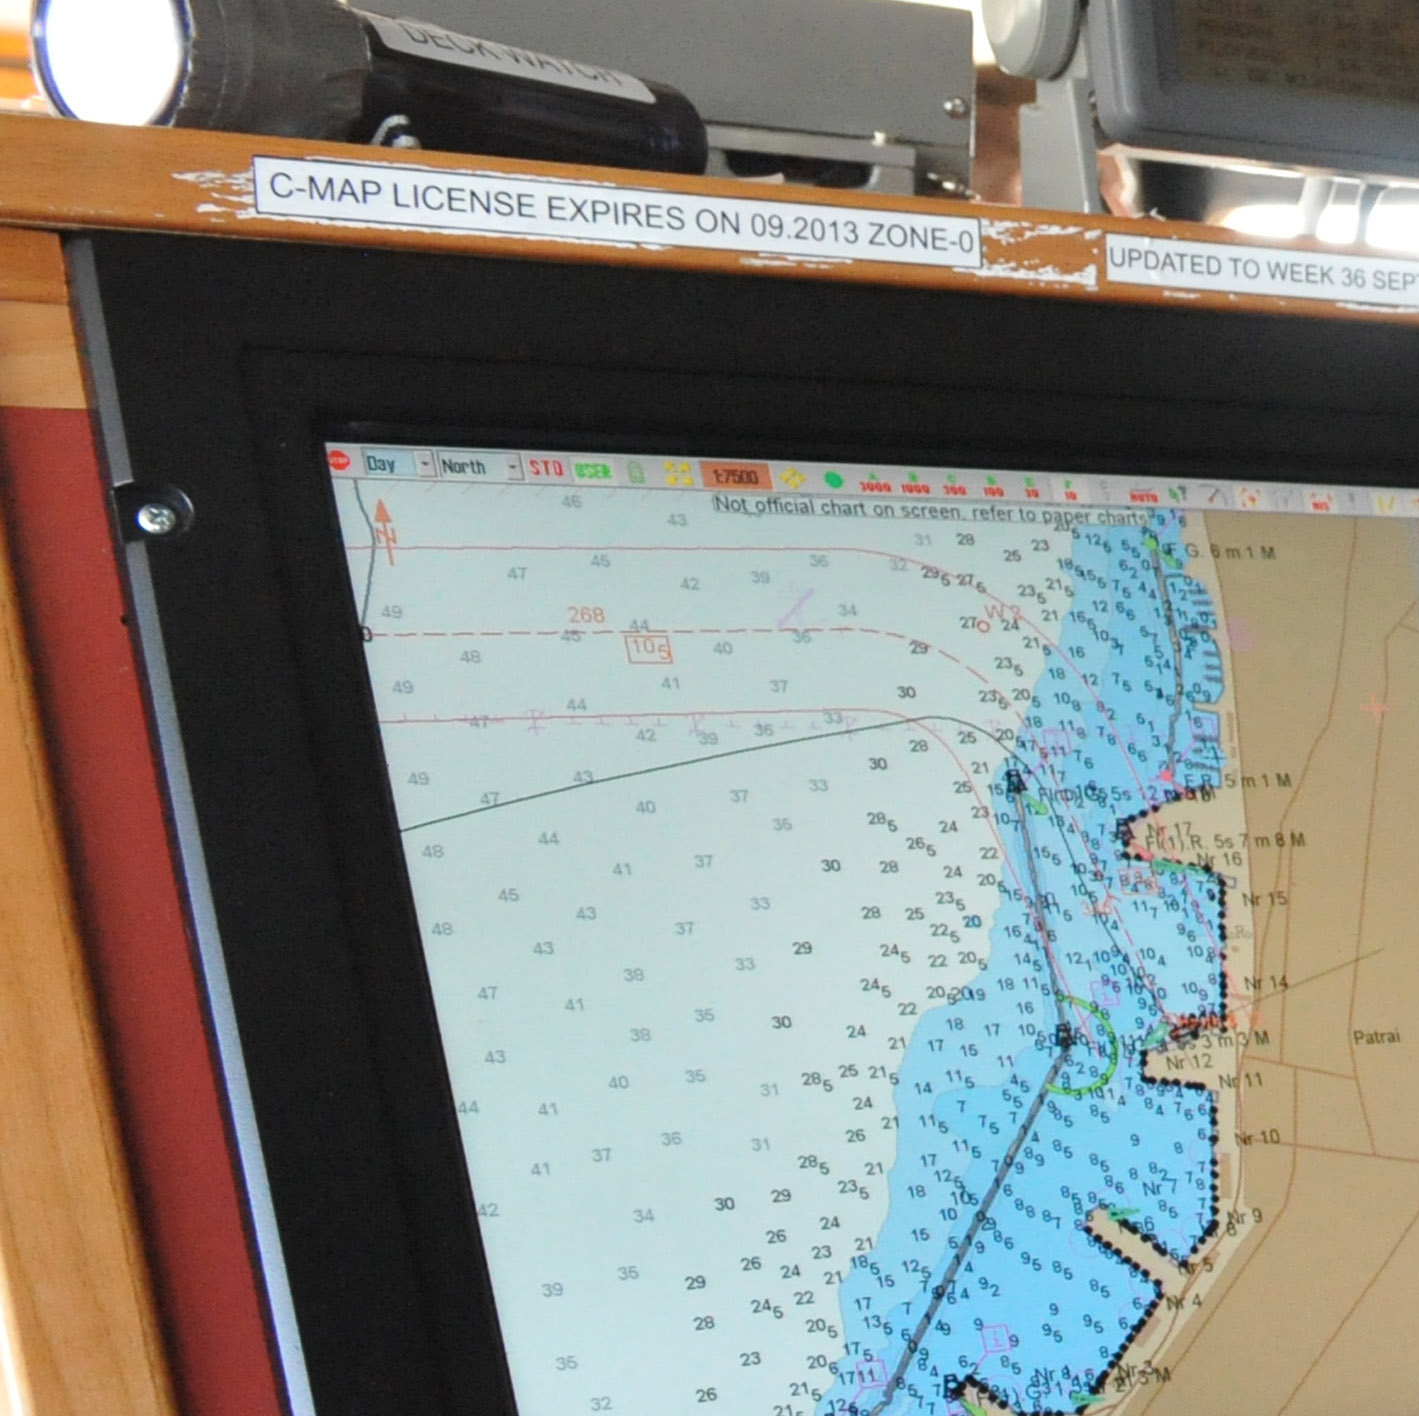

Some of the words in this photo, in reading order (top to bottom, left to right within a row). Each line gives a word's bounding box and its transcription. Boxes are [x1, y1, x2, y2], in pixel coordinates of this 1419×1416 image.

[269, 171, 383, 206] C-MAP
[392, 182, 538, 219] LICENSE
[547, 196, 687, 233] EXPIRES
[695, 209, 741, 237] ON
[750, 213, 860, 247] 09.2013
[867, 222, 975, 256] ZONE-0
[1108, 245, 1223, 278] UPDATED
[1230, 254, 1262, 281] TO
[1267, 257, 1337, 289] WEEK
[1341, 264, 1368, 290] 36
[365, 455, 396, 475] Day
[441, 457, 487, 475] North
[714, 494, 749, 515] Not
[753, 497, 816, 516] official
[820, 499, 868, 517] chart
[873, 505, 895, 518] on
[972, 504, 1015, 521] refer
[1018, 507, 1038, 523] to
[1042, 511, 1092, 528] paper
[1096, 510, 1147, 527] charts
[567, 606, 606, 623] 268
[821, 857, 841, 873] 30
[792, 940, 813, 956] 29
[1353, 1028, 1402, 1045] Patrai
[715, 1196, 736, 1212] 30
[685, 1275, 706, 1291] 29
